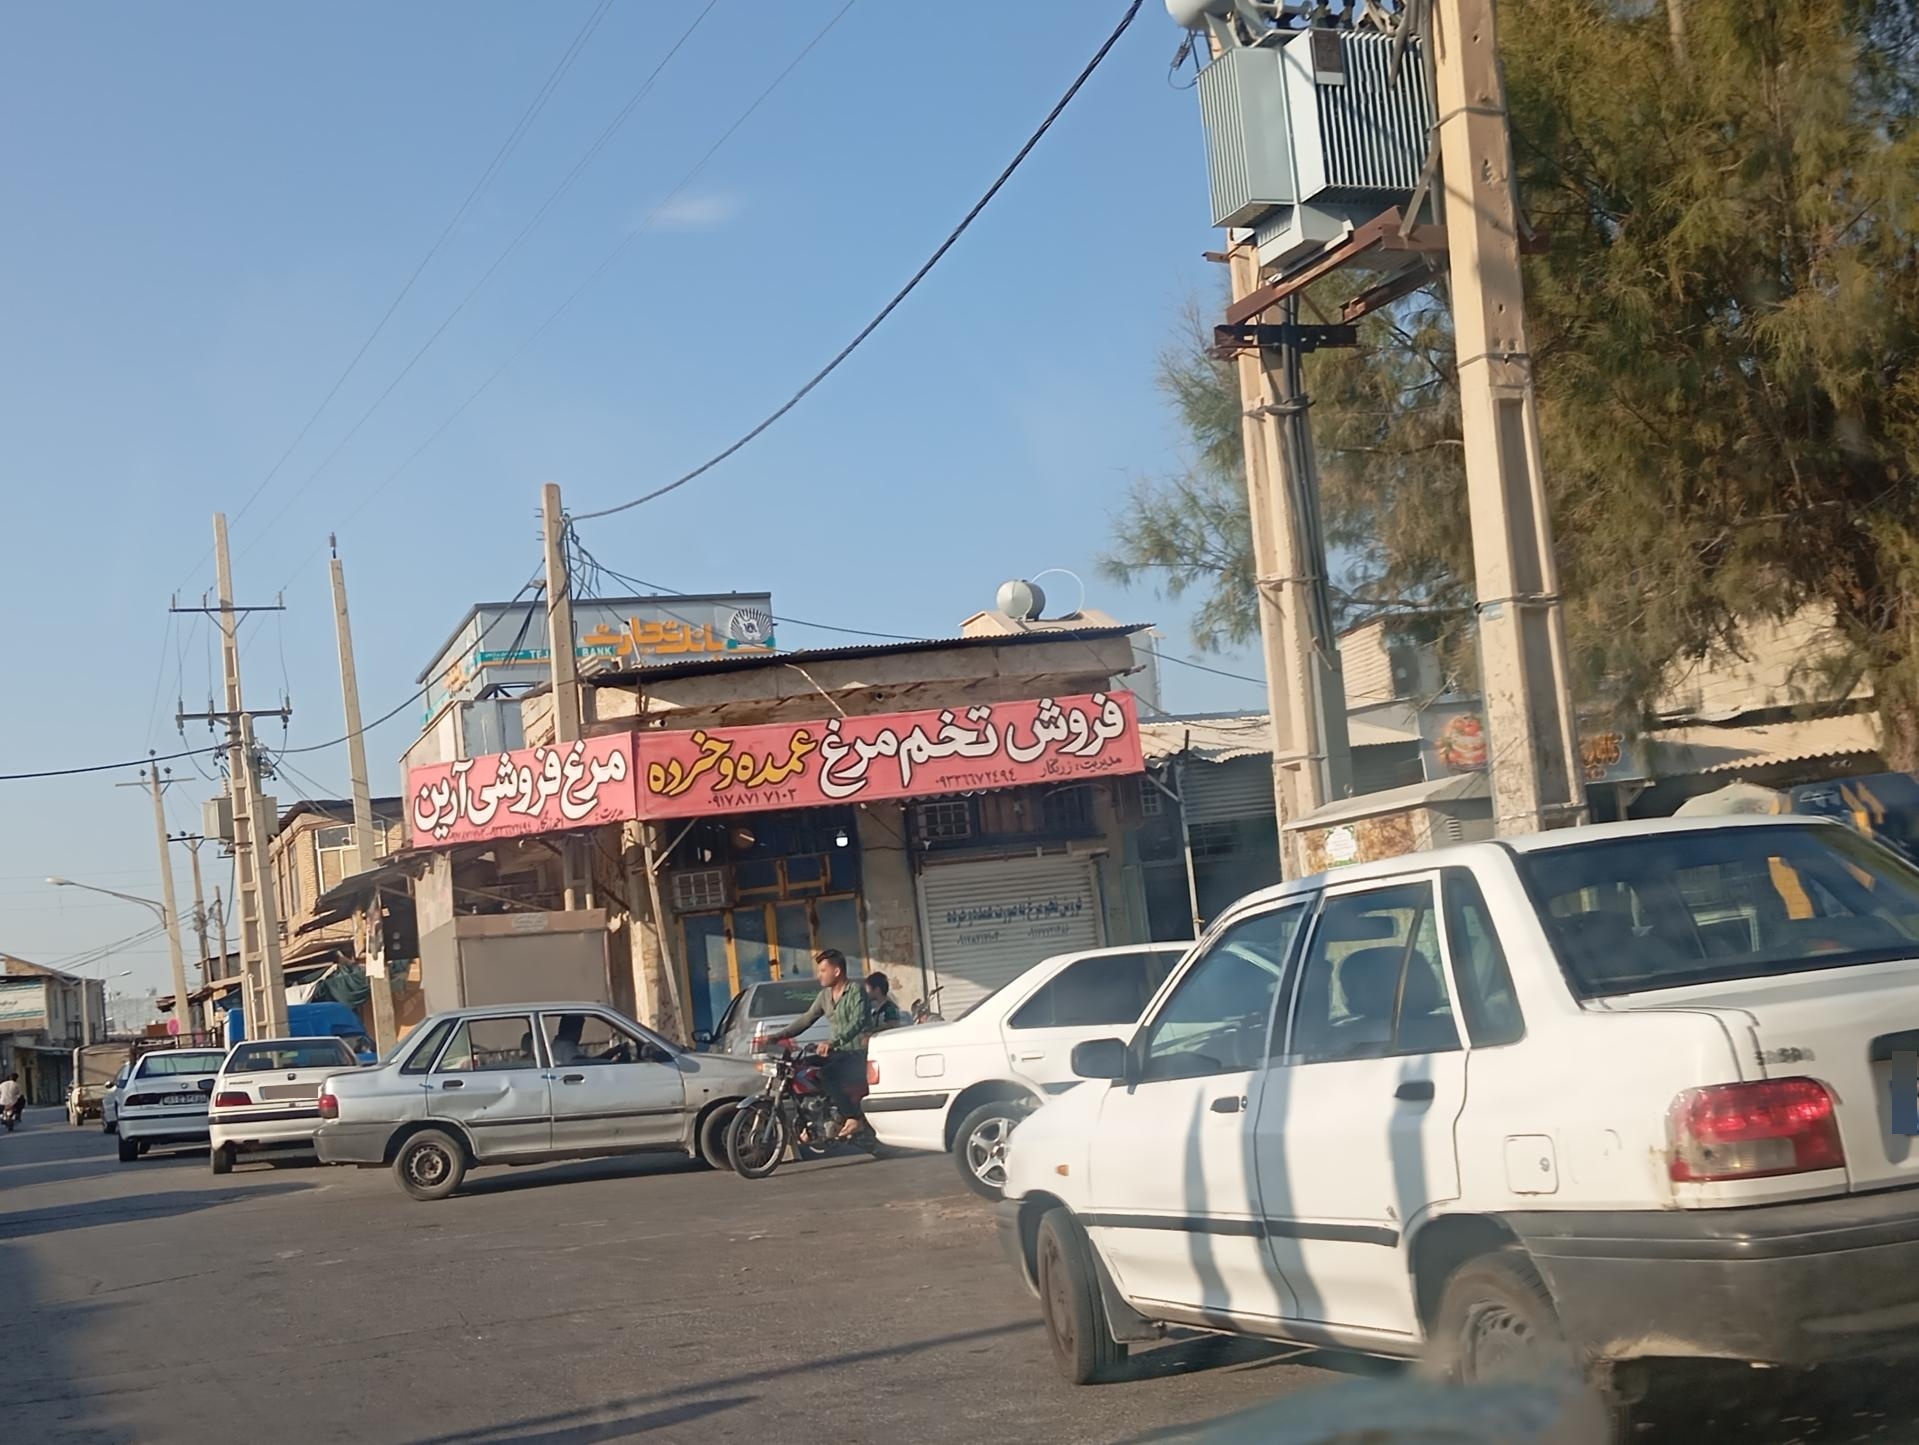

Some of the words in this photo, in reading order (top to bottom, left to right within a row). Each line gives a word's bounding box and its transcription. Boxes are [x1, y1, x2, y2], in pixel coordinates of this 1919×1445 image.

[581, 646, 613, 657] BANK
[582, 616, 683, 656] تجارت
[655, 623, 725, 661] بانک
[736, 729, 819, 789] عمده
[819, 718, 899, 799] مرغ
[899, 705, 999, 788] تخم
[1005, 691, 1126, 763] فروش
[467, 746, 562, 827] فروشی
[560, 739, 628, 821] مرغ
[648, 730, 735, 797] خرده
[710, 755, 735, 791] و
[413, 758, 475, 839] آرین
